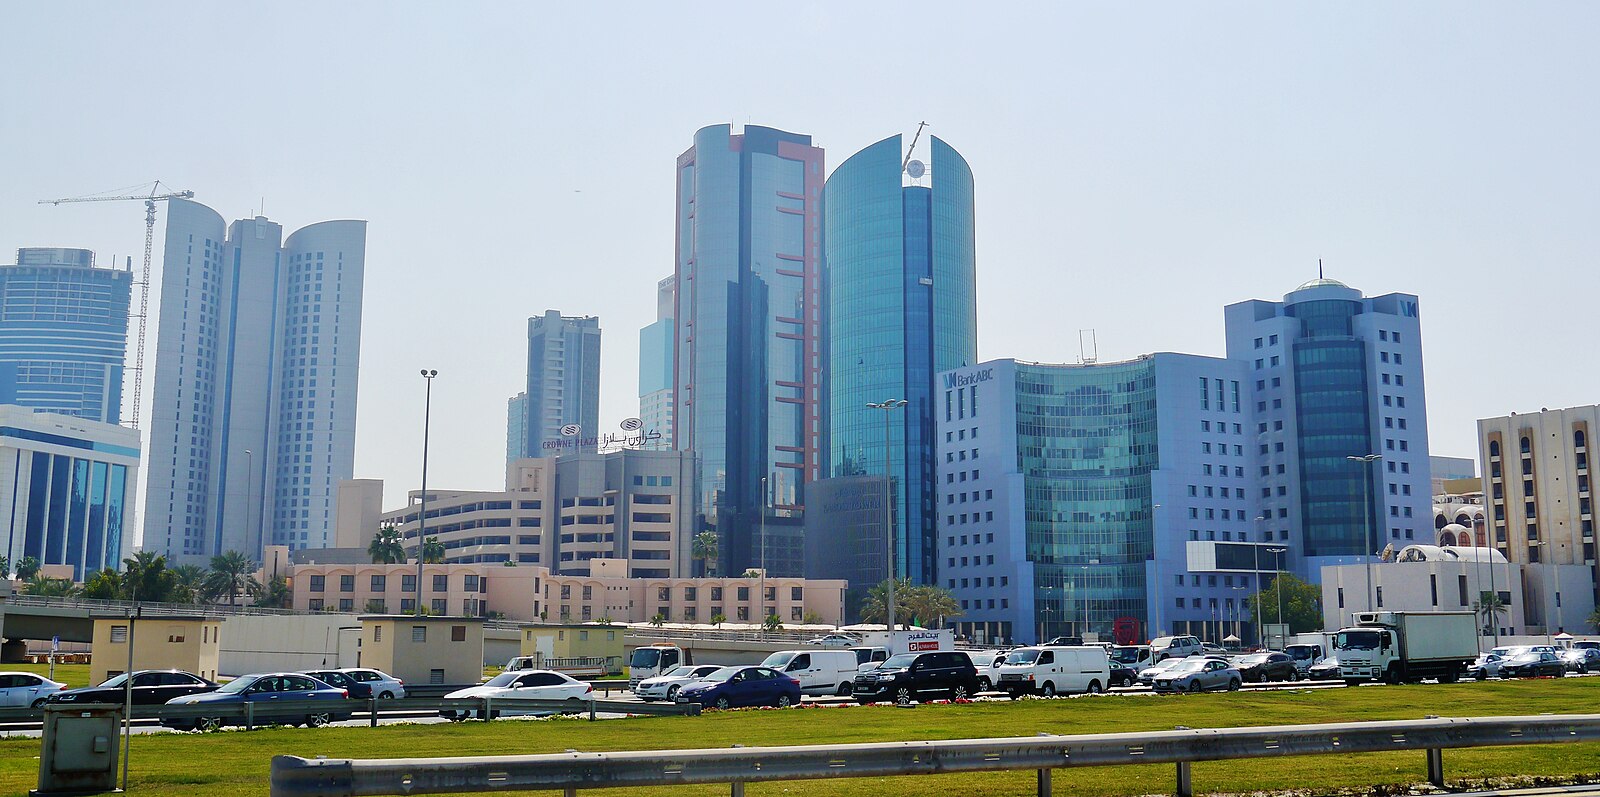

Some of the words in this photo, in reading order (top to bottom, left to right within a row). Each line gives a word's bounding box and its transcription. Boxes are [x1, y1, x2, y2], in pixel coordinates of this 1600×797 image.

[542, 439, 573, 450] CROWNE
[575, 437, 599, 447] PLAZA
[628, 429, 662, 446] كراون
